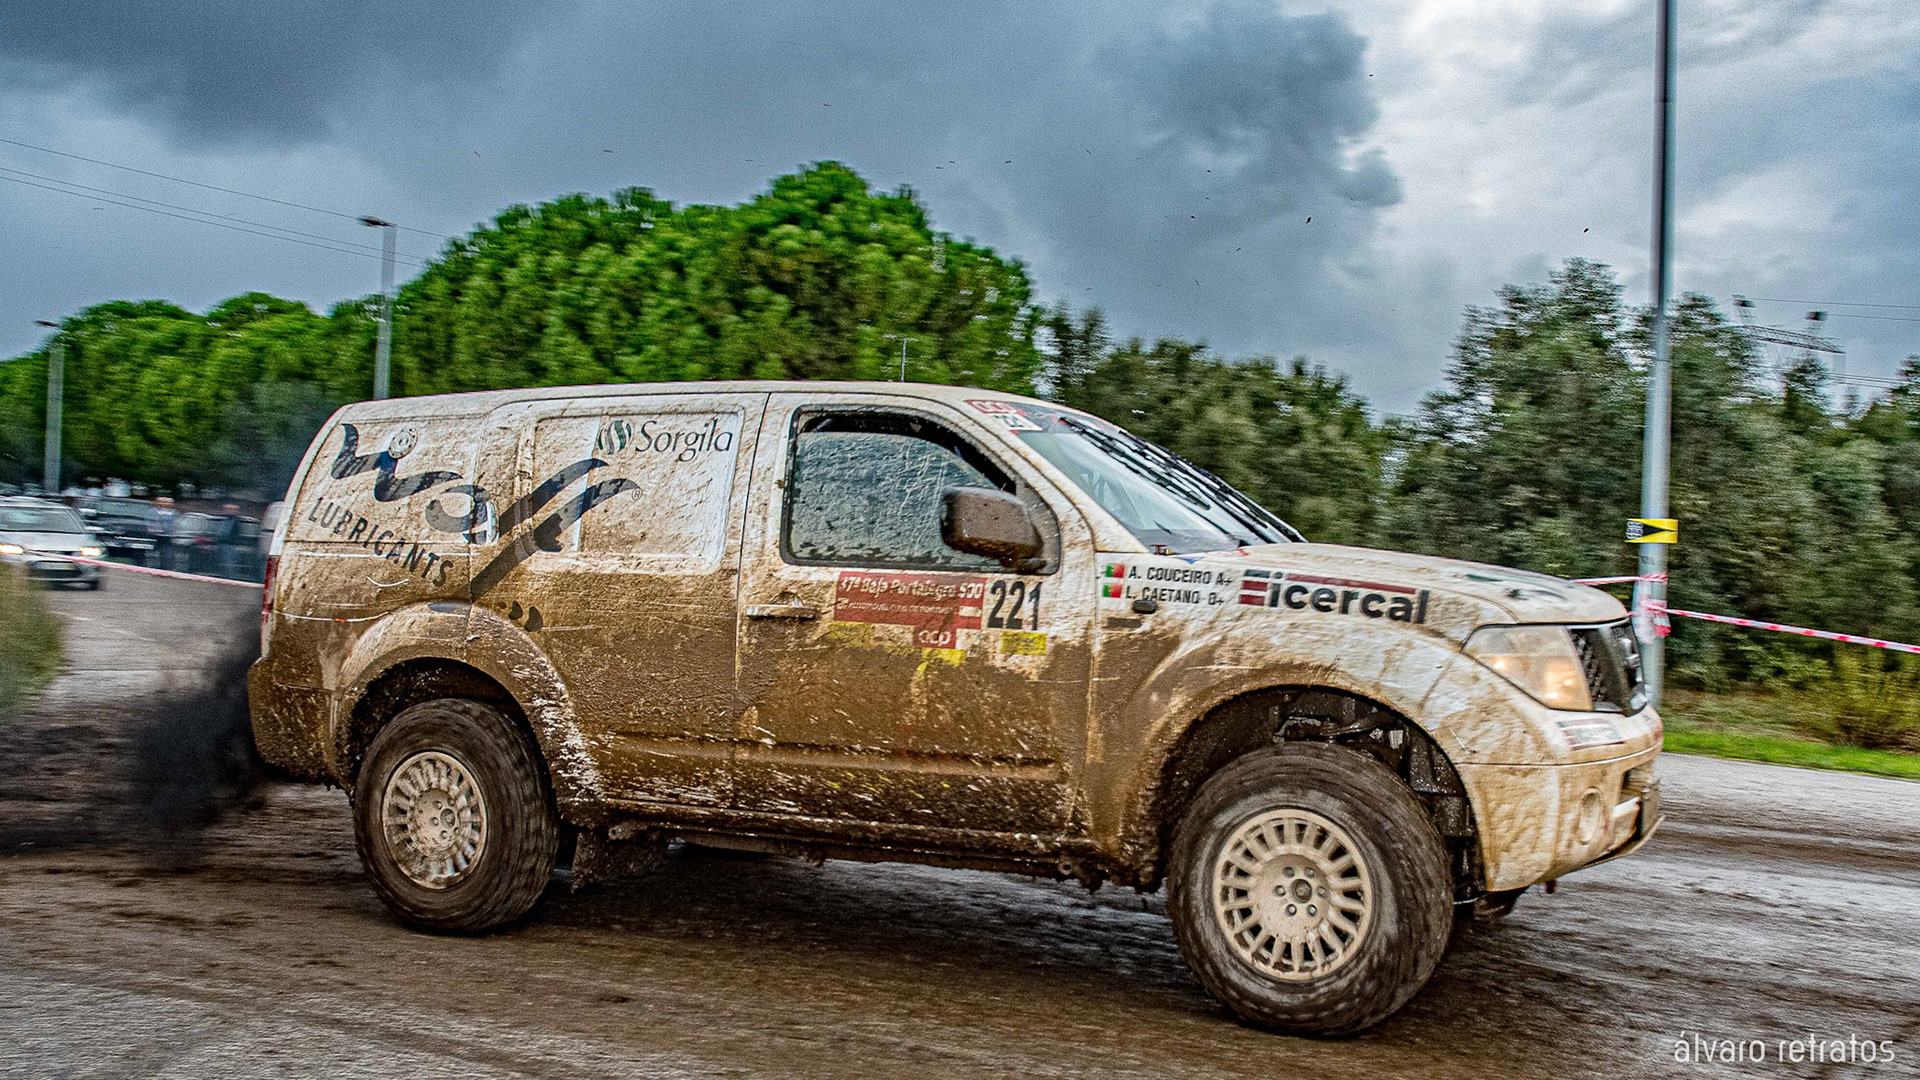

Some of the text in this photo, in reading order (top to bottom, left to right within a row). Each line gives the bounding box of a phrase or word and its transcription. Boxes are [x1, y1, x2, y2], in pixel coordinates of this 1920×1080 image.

[635, 417, 733, 462] Sorgila
[307, 497, 453, 588] LUBRICANTS
[861, 577, 889, 598] Baja
[957, 583, 983, 600] 500
[1128, 566, 1233, 586] A. COUCEIRO A+
[1142, 587, 1200, 604] CAETANO
[1268, 572, 1431, 624] icercal
[987, 580, 1043, 631] 221
